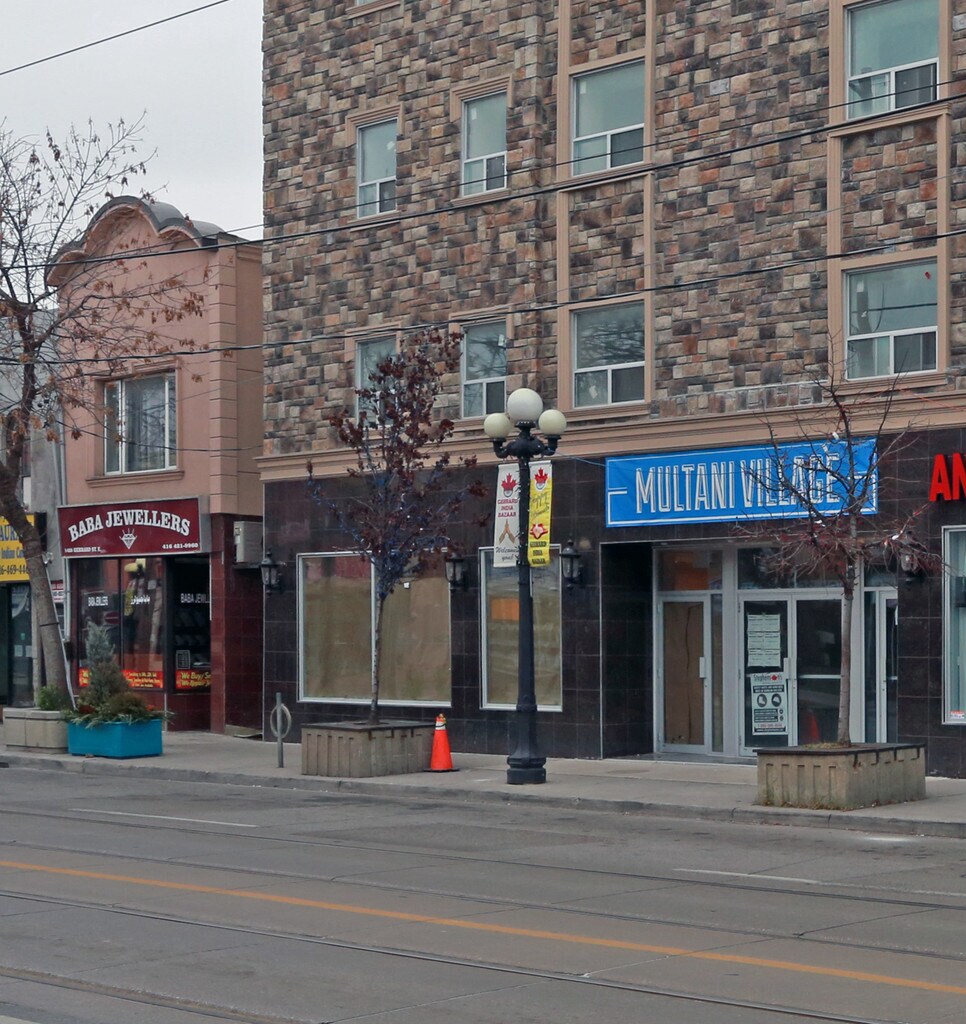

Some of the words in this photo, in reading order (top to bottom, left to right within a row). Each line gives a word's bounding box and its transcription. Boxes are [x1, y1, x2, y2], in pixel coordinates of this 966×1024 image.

[636, 461, 735, 514] MULTANI
[740, 453, 840, 508] VILLAGE
[68, 514, 104, 543] BABA
[105, 509, 191, 537] JEWELLERS
[181, 593, 194, 604] BABA
